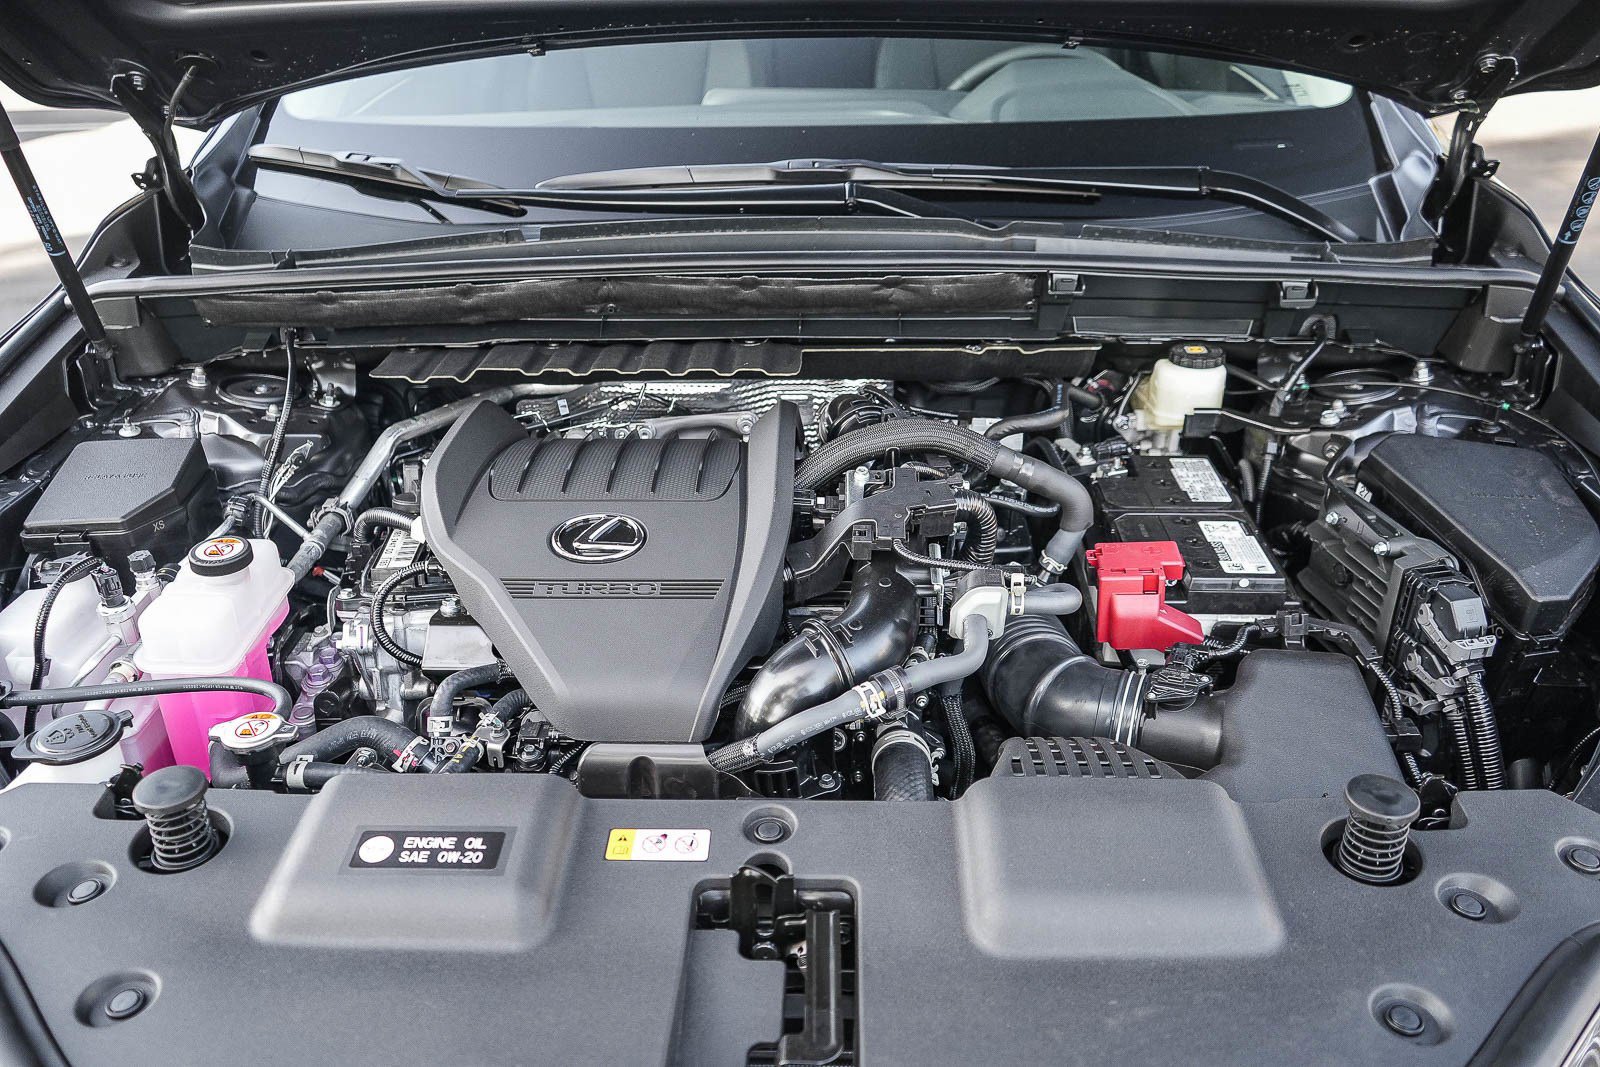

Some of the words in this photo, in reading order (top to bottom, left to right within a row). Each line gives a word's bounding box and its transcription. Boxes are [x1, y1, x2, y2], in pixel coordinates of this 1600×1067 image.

[1359, 486, 1369, 497] 27
[152, 520, 164, 532] XS
[534, 581, 659, 596] TURBO
[402, 836, 458, 849] ENGINE
[463, 836, 487, 849] OIL
[398, 850, 430, 863] SAE
[436, 851, 484, 864] 0W-20
